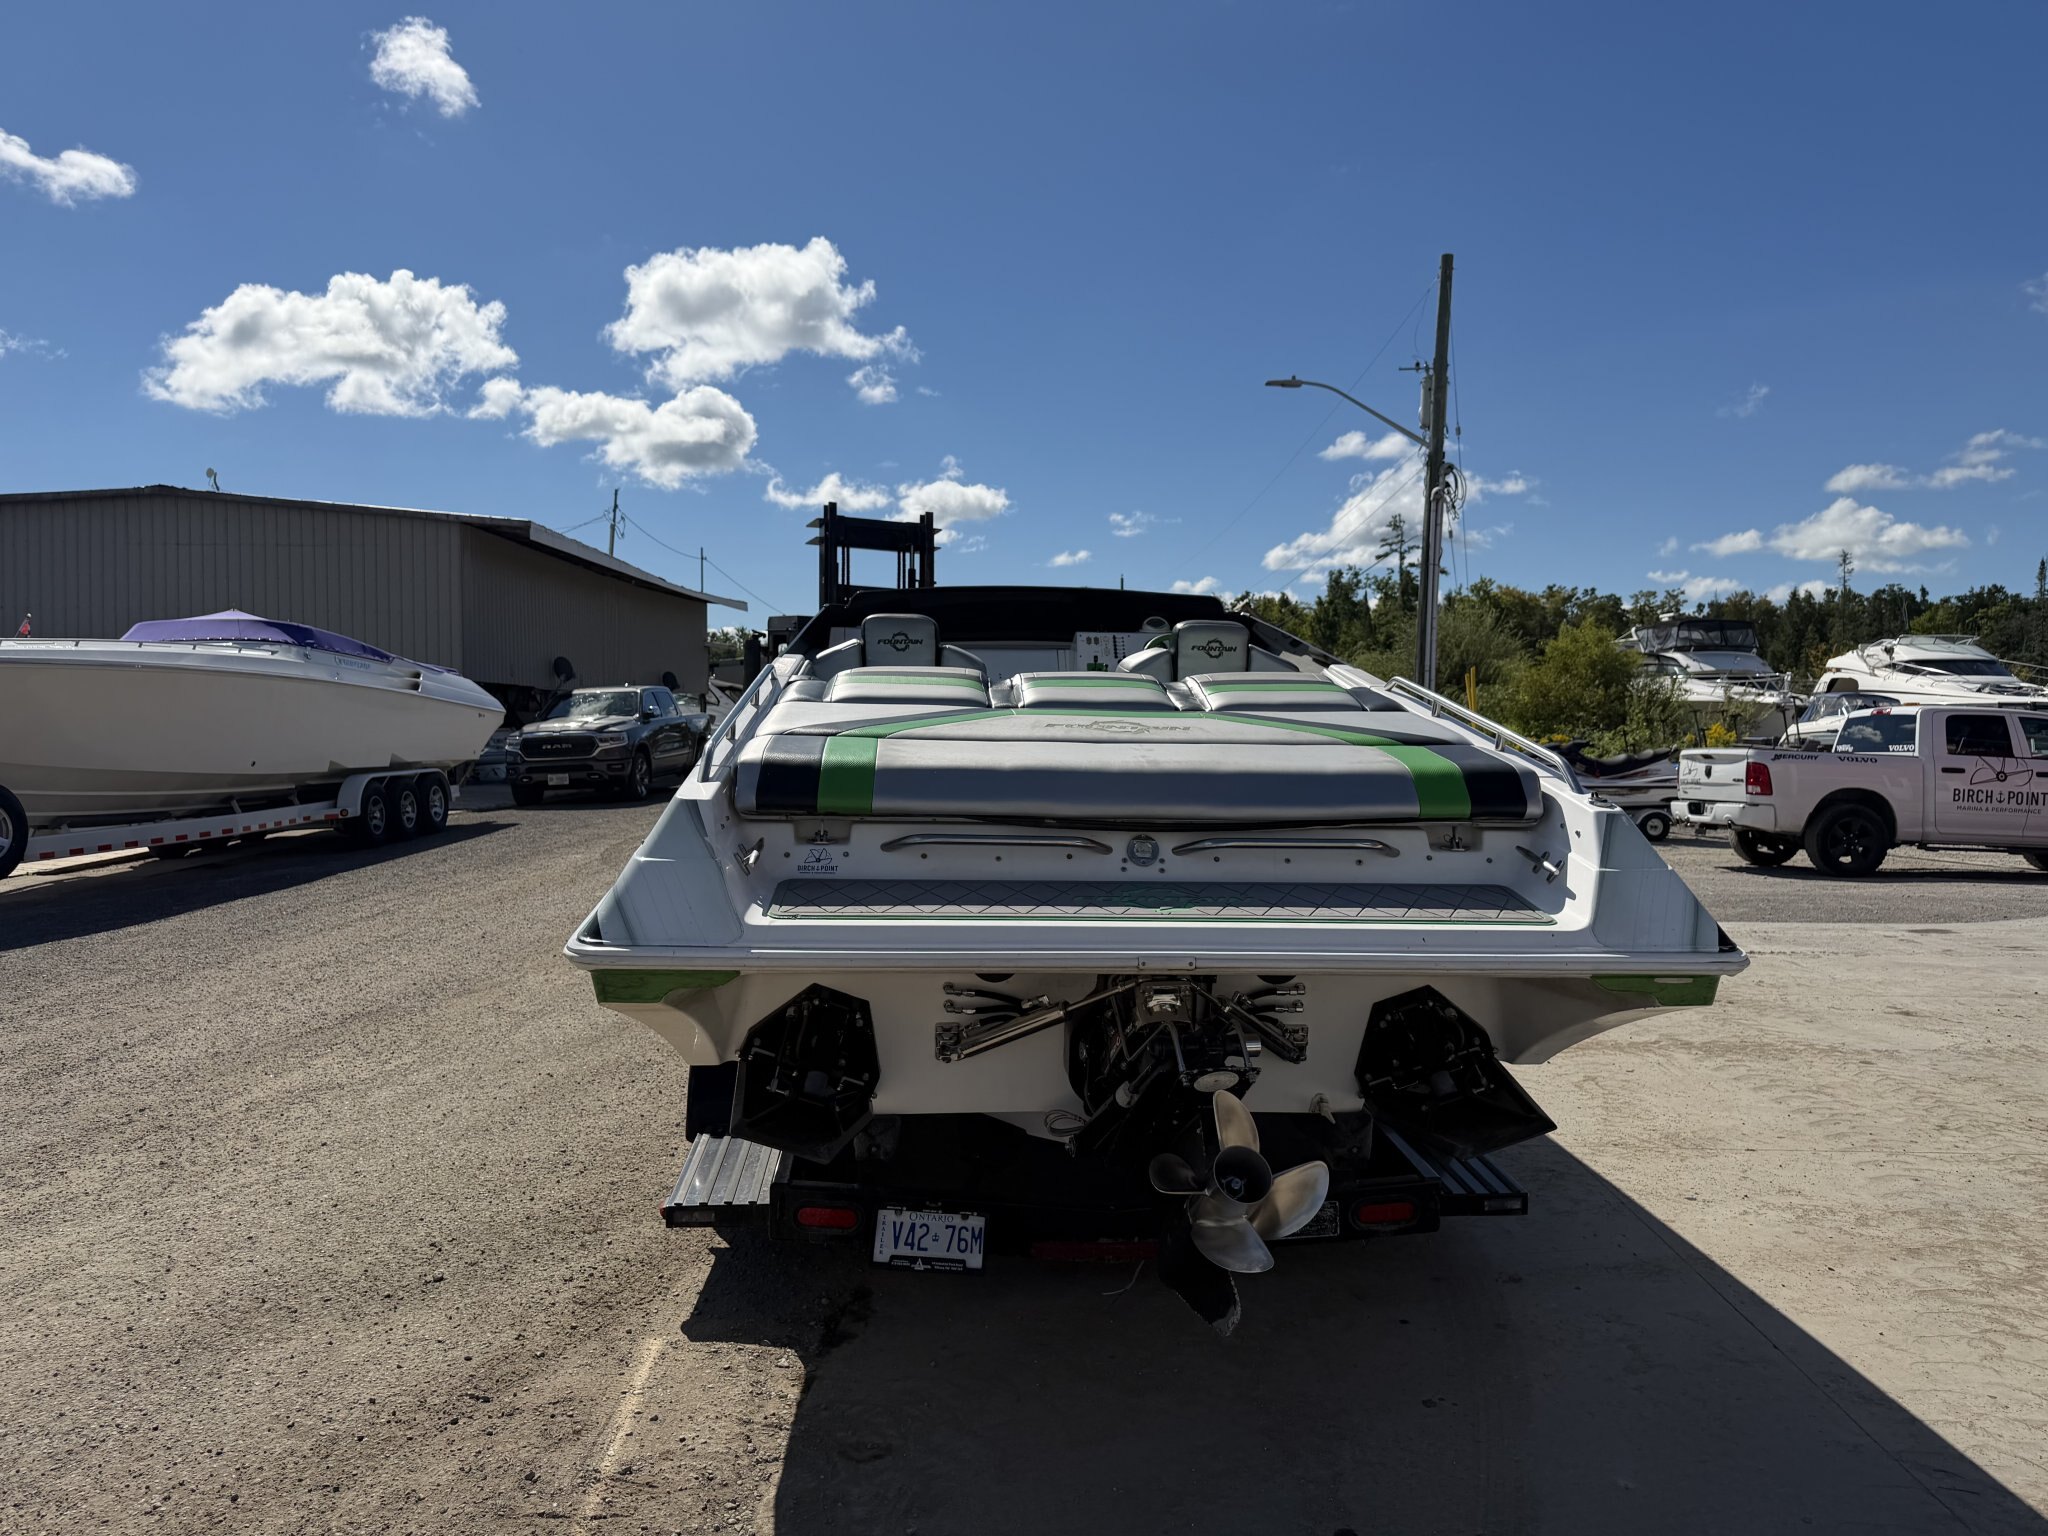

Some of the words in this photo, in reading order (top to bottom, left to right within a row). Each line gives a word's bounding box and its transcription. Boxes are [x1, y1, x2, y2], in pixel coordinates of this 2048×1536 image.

[1888, 744, 1915, 752] VOLVO
[1771, 753, 1820, 762] MERCURY
[1837, 756, 1878, 764] VOLVO
[1952, 788, 1994, 804] BIRCH
[2007, 790, 2048, 806] POINT
[1991, 806, 2042, 815] PERFORMANCE
[909, 1212, 954, 1223] ONTARIO
[879, 1215, 887, 1255] TRAILER
